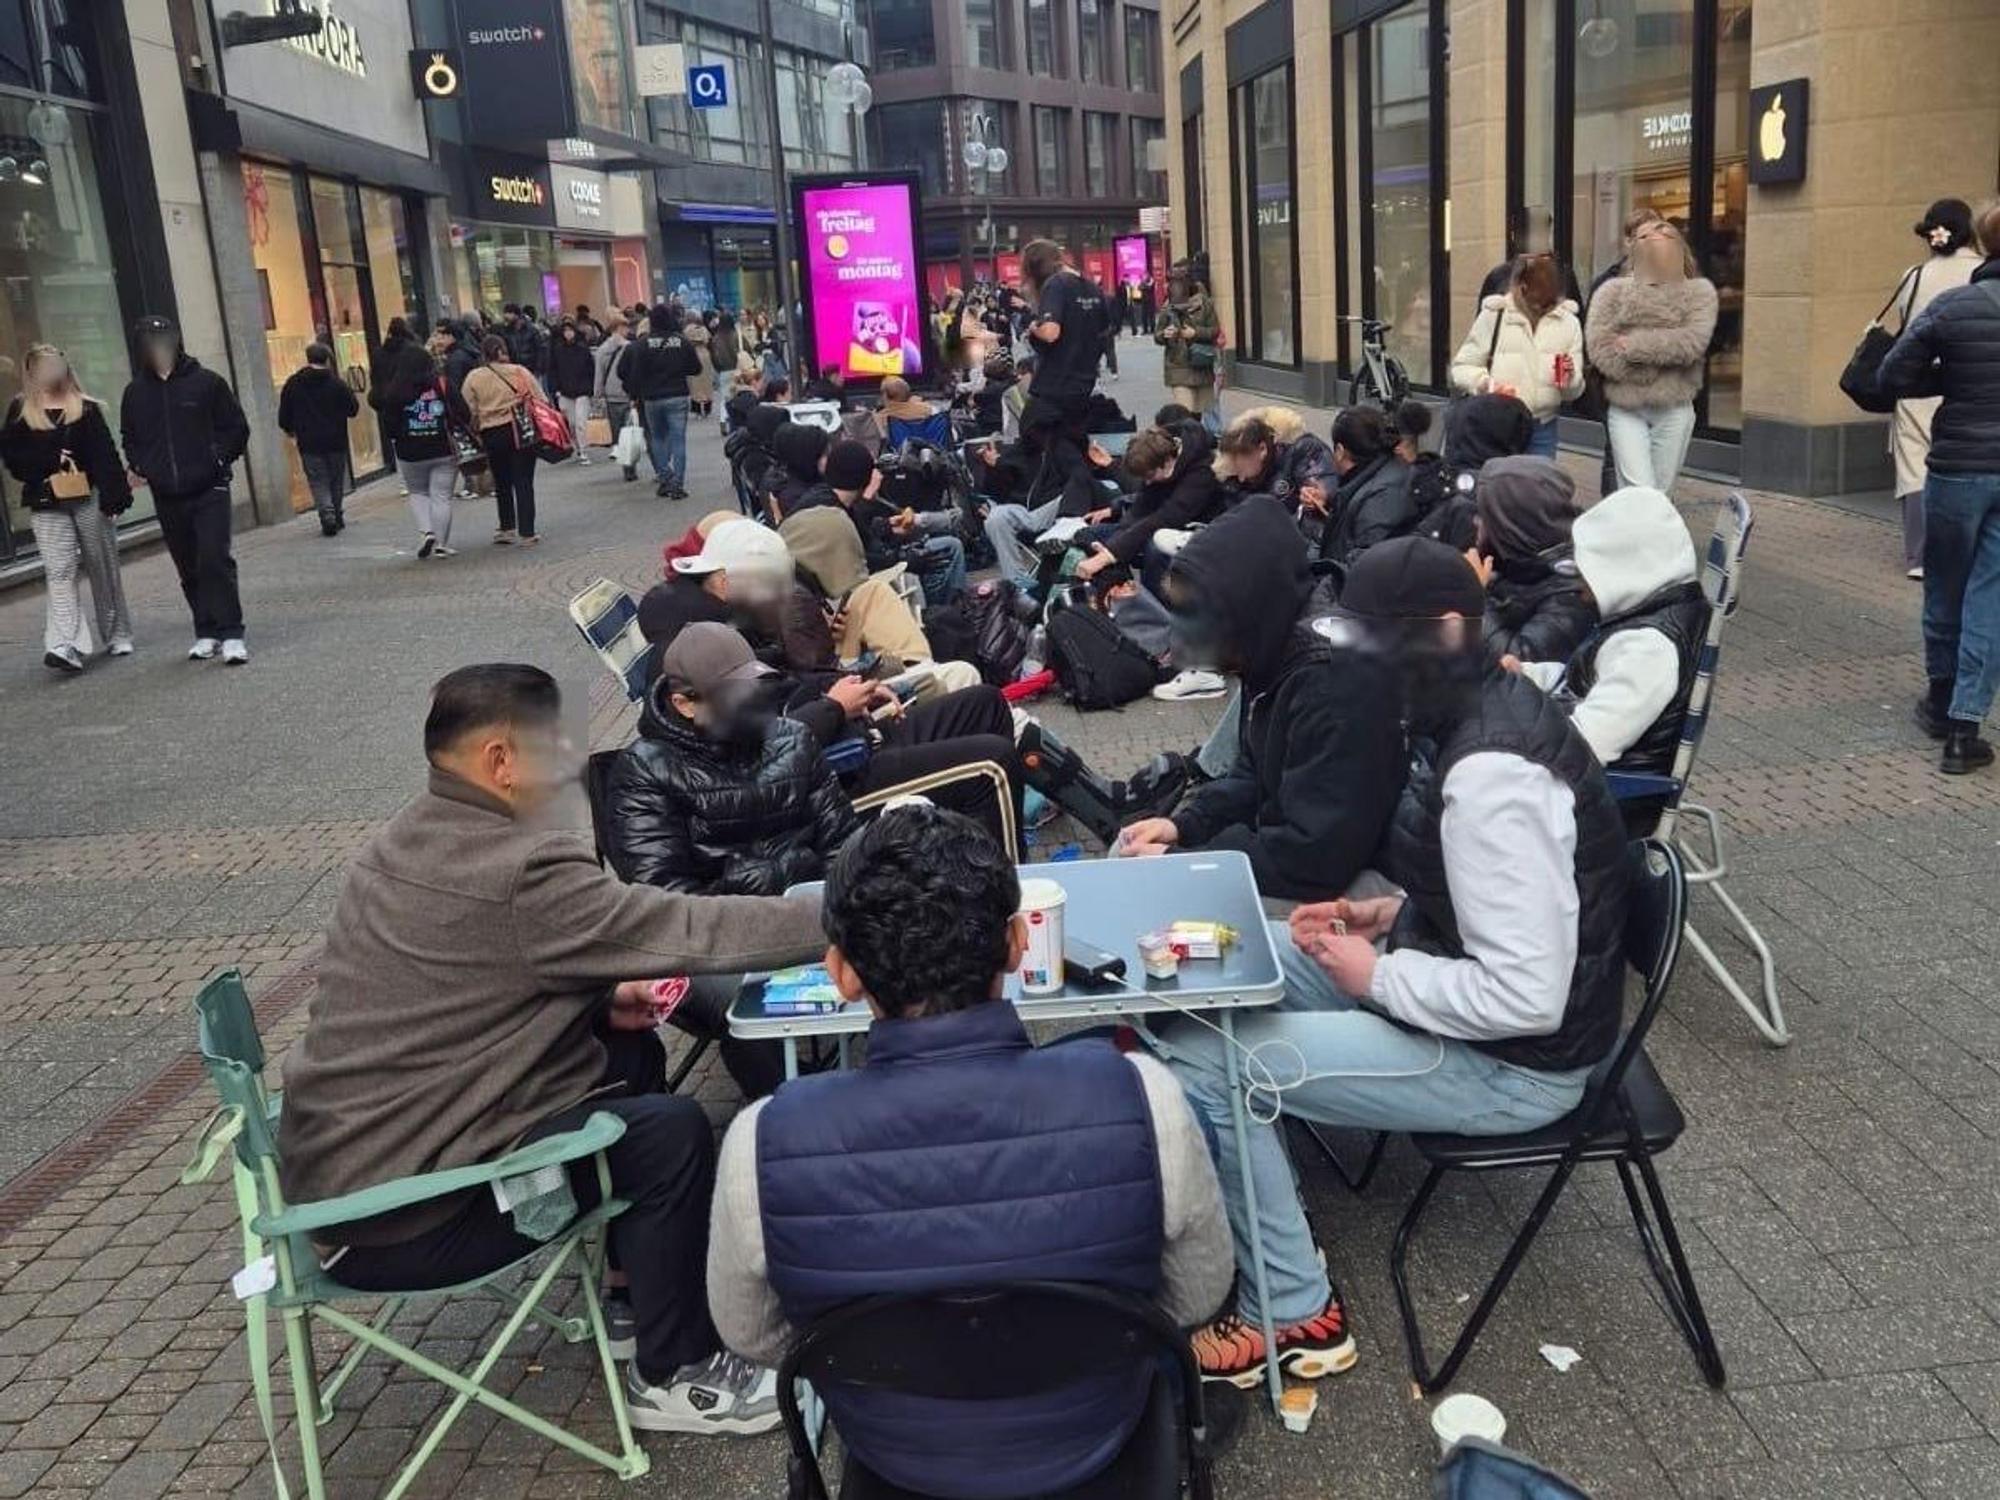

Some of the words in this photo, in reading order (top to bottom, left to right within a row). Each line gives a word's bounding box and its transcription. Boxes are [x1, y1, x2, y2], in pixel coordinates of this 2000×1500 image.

[469, 26, 533, 44] swatch
[492, 176, 536, 204] swatch
[838, 262, 904, 281] montag
